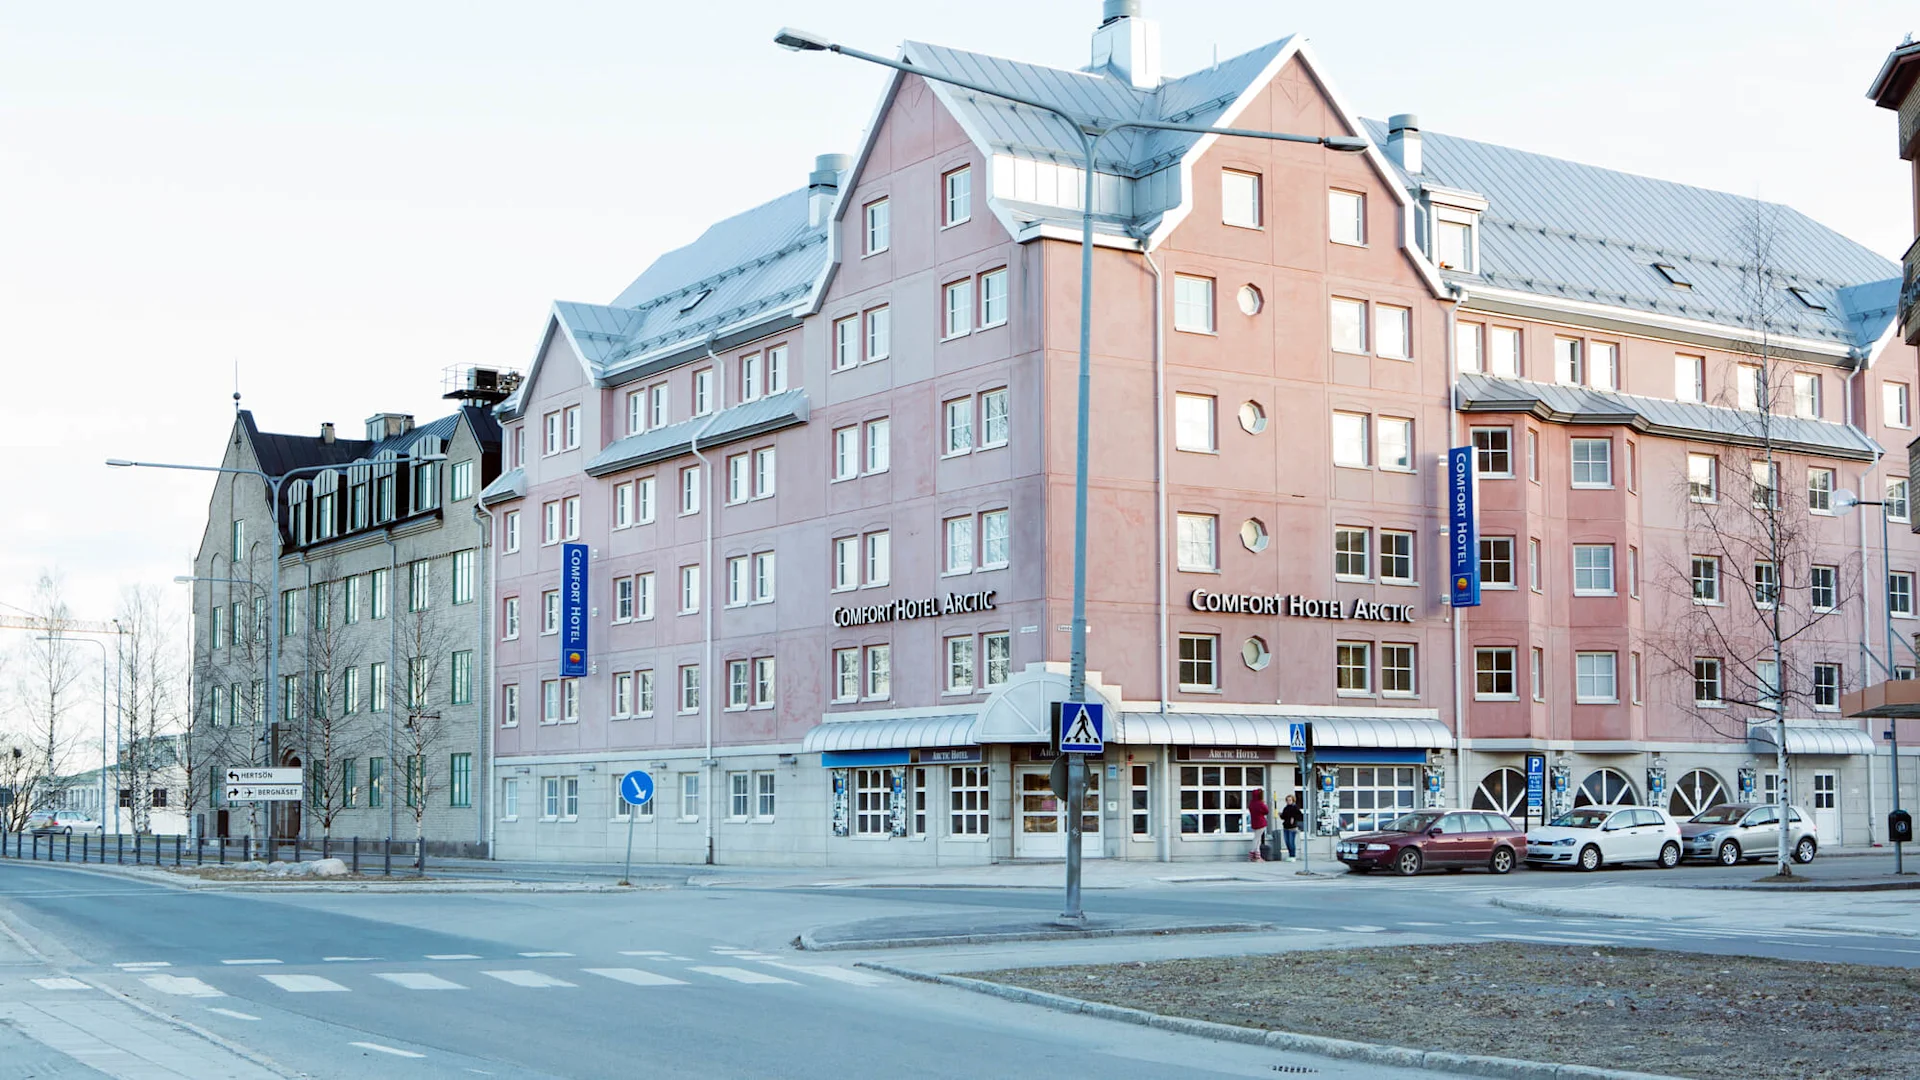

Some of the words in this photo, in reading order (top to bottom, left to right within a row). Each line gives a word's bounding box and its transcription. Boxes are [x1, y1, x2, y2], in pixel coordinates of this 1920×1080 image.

[1456, 453, 1467, 518] COMFORT
[1457, 522, 1467, 567] HOTEL
[571, 549, 582, 603] COMFORT
[832, 601, 894, 628] COMFORT
[895, 598, 940, 621] HOTEL
[943, 590, 996, 615] ARCTIC
[1191, 588, 1285, 615] COMFORT
[1288, 594, 1349, 619] HOTEL
[1353, 598, 1415, 623] ARCTIC
[571, 606, 581, 643] HOTEL
[932, 750, 950, 760] ARCTIC
[951, 749, 968, 760] HOTEL
[1208, 748, 1235, 759] ARCTIC
[1236, 748, 1259, 759] HOTEL
[1531, 758, 1540, 772] P
[241, 771, 273, 779] HERTSÖN
[257, 787, 298, 796] BERGNÄSET
